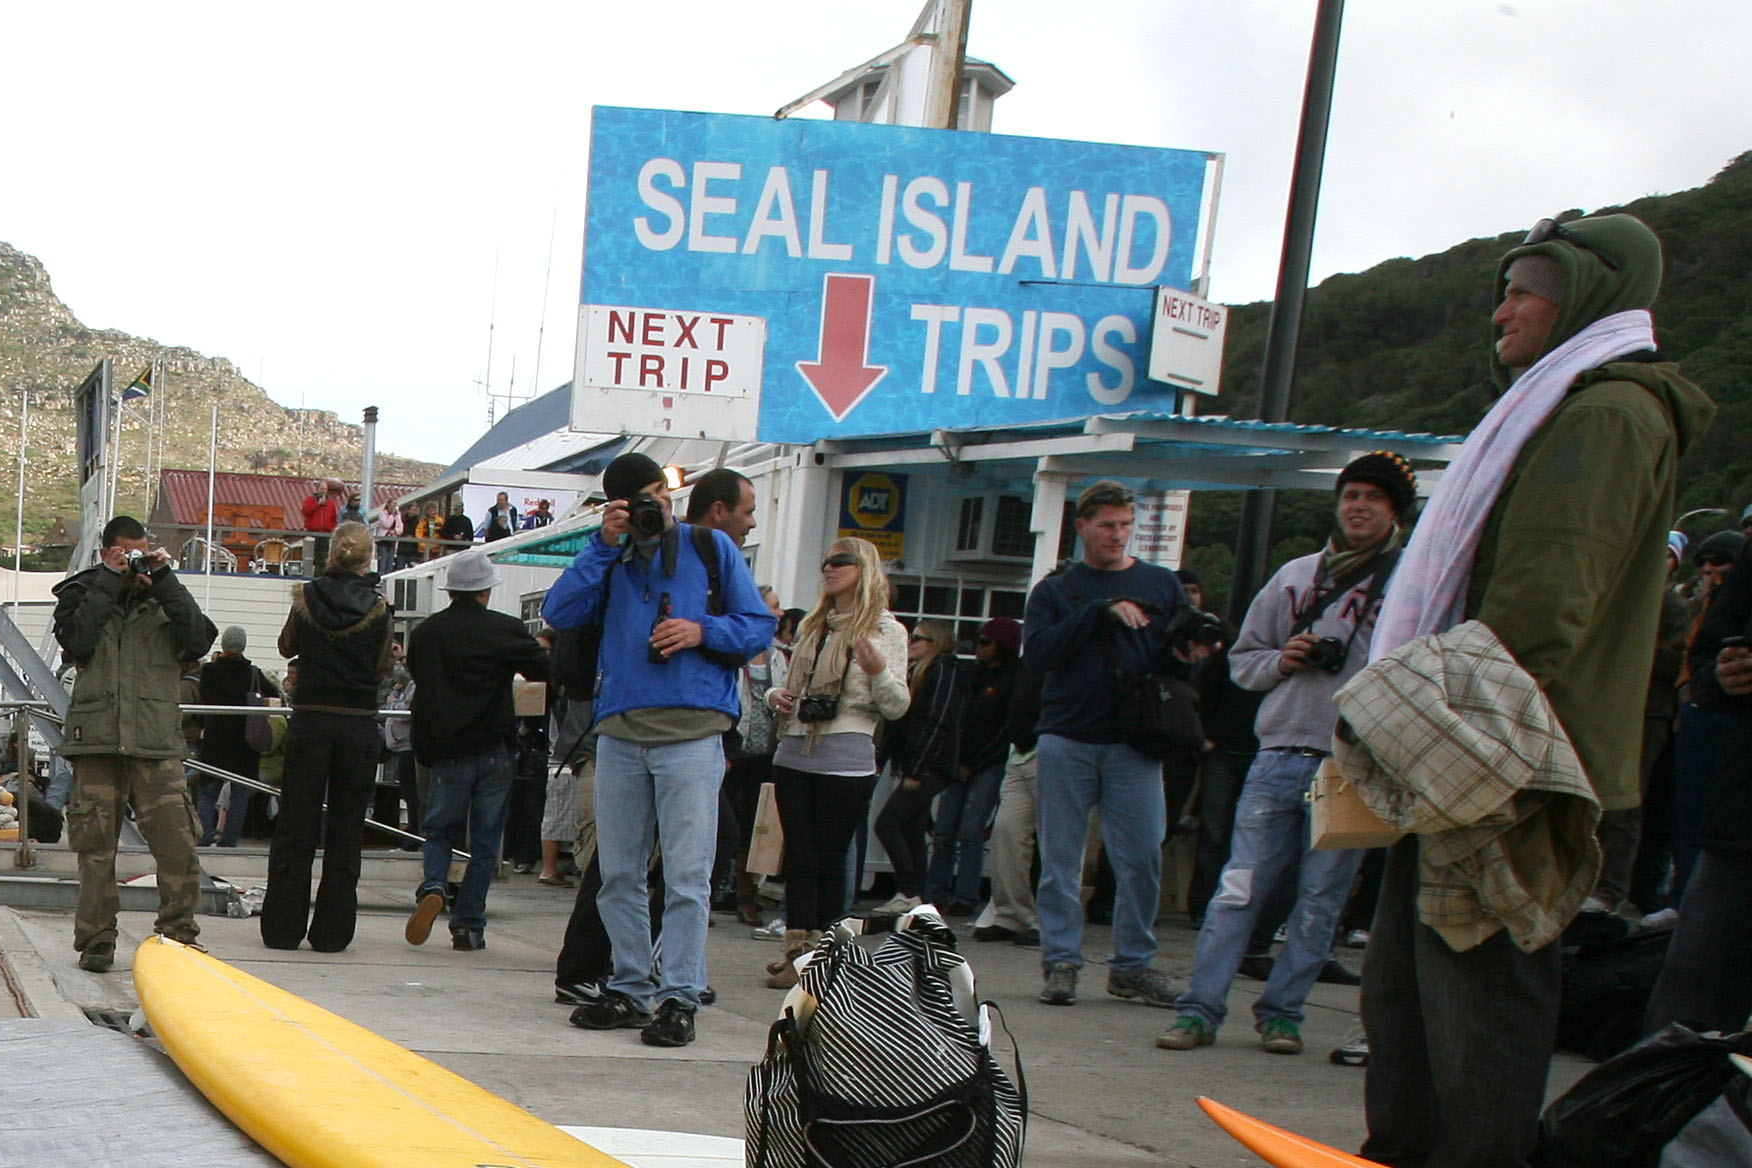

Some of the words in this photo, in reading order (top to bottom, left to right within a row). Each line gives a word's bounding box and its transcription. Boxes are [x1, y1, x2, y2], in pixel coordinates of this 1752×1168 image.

[633, 157, 854, 261] SEAL
[876, 174, 1173, 285] ISLAND
[608, 310, 734, 351] NEXT
[1162, 295, 1193, 322] NEXT
[1197, 306, 1221, 330] TRIP
[607, 352, 729, 391] TRIP
[910, 304, 1137, 405] TRIPS
[857, 492, 890, 511] ADT
